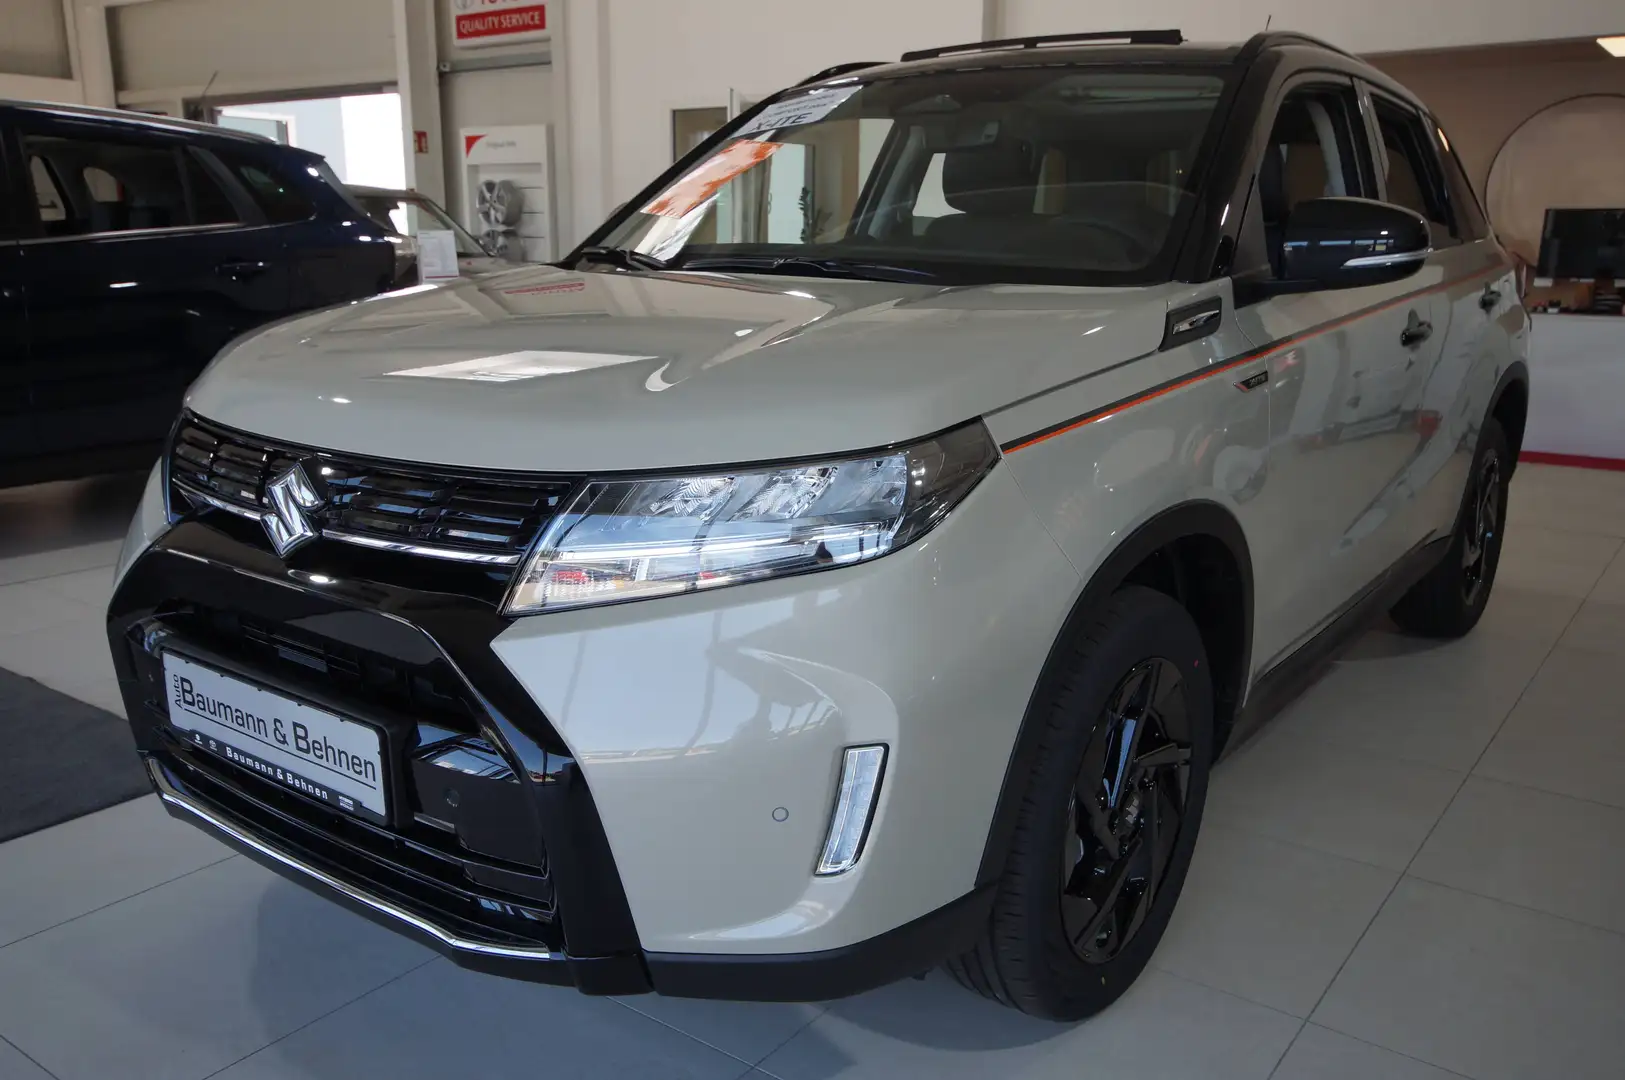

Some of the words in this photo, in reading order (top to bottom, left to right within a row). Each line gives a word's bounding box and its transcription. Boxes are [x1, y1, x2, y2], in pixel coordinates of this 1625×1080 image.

[460, 17, 498, 34] QUALITY
[501, 12, 539, 27] SERVICE
[173, 674, 182, 709] Auto
[180, 677, 268, 738] Baumann
[273, 718, 289, 746] &
[292, 721, 376, 782] Behnen
[226, 746, 273, 775] Baumann
[276, 768, 285, 780] &
[286, 773, 328, 800] Behnen
